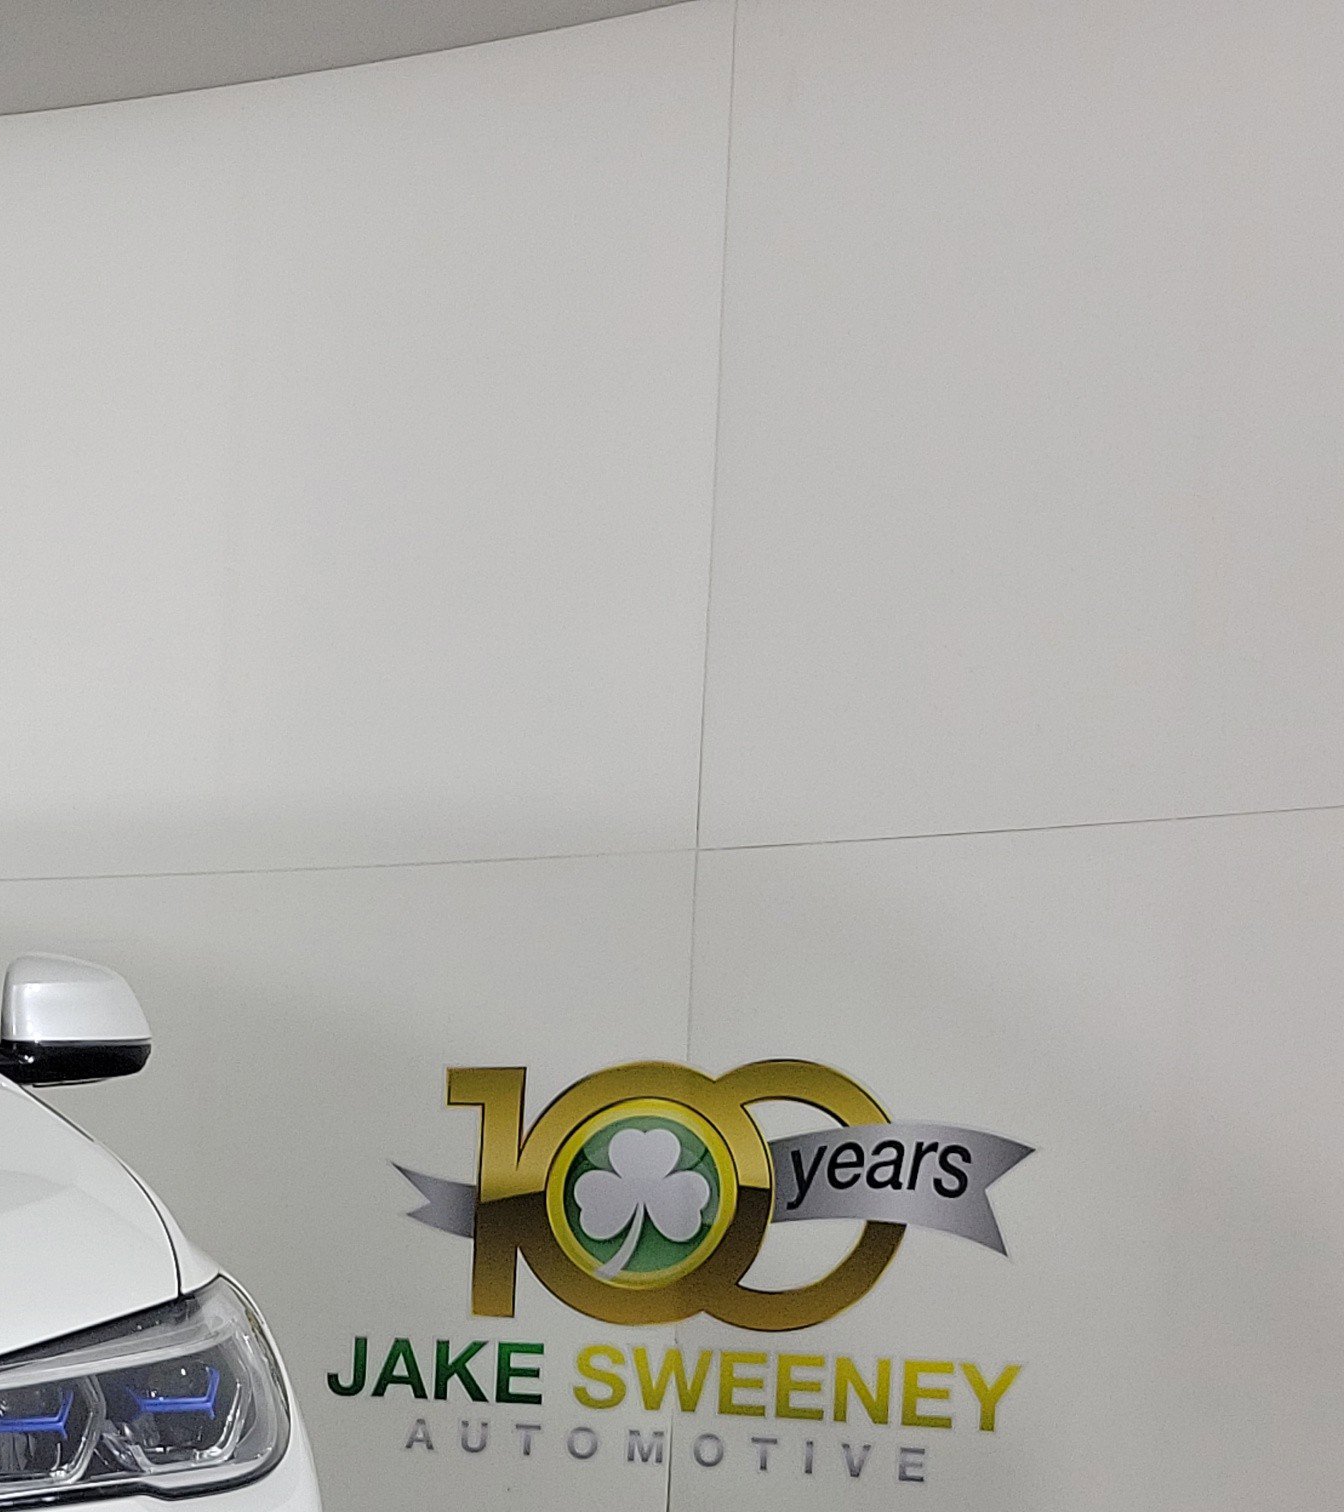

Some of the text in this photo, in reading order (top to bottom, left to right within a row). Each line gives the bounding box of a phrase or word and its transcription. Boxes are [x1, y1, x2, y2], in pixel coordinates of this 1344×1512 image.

[446, 1059, 973, 1331] 100 years
[326, 1336, 1023, 1432] JAKE SWEENEY
[404, 1417, 926, 1483] AUTOMOTIVE
